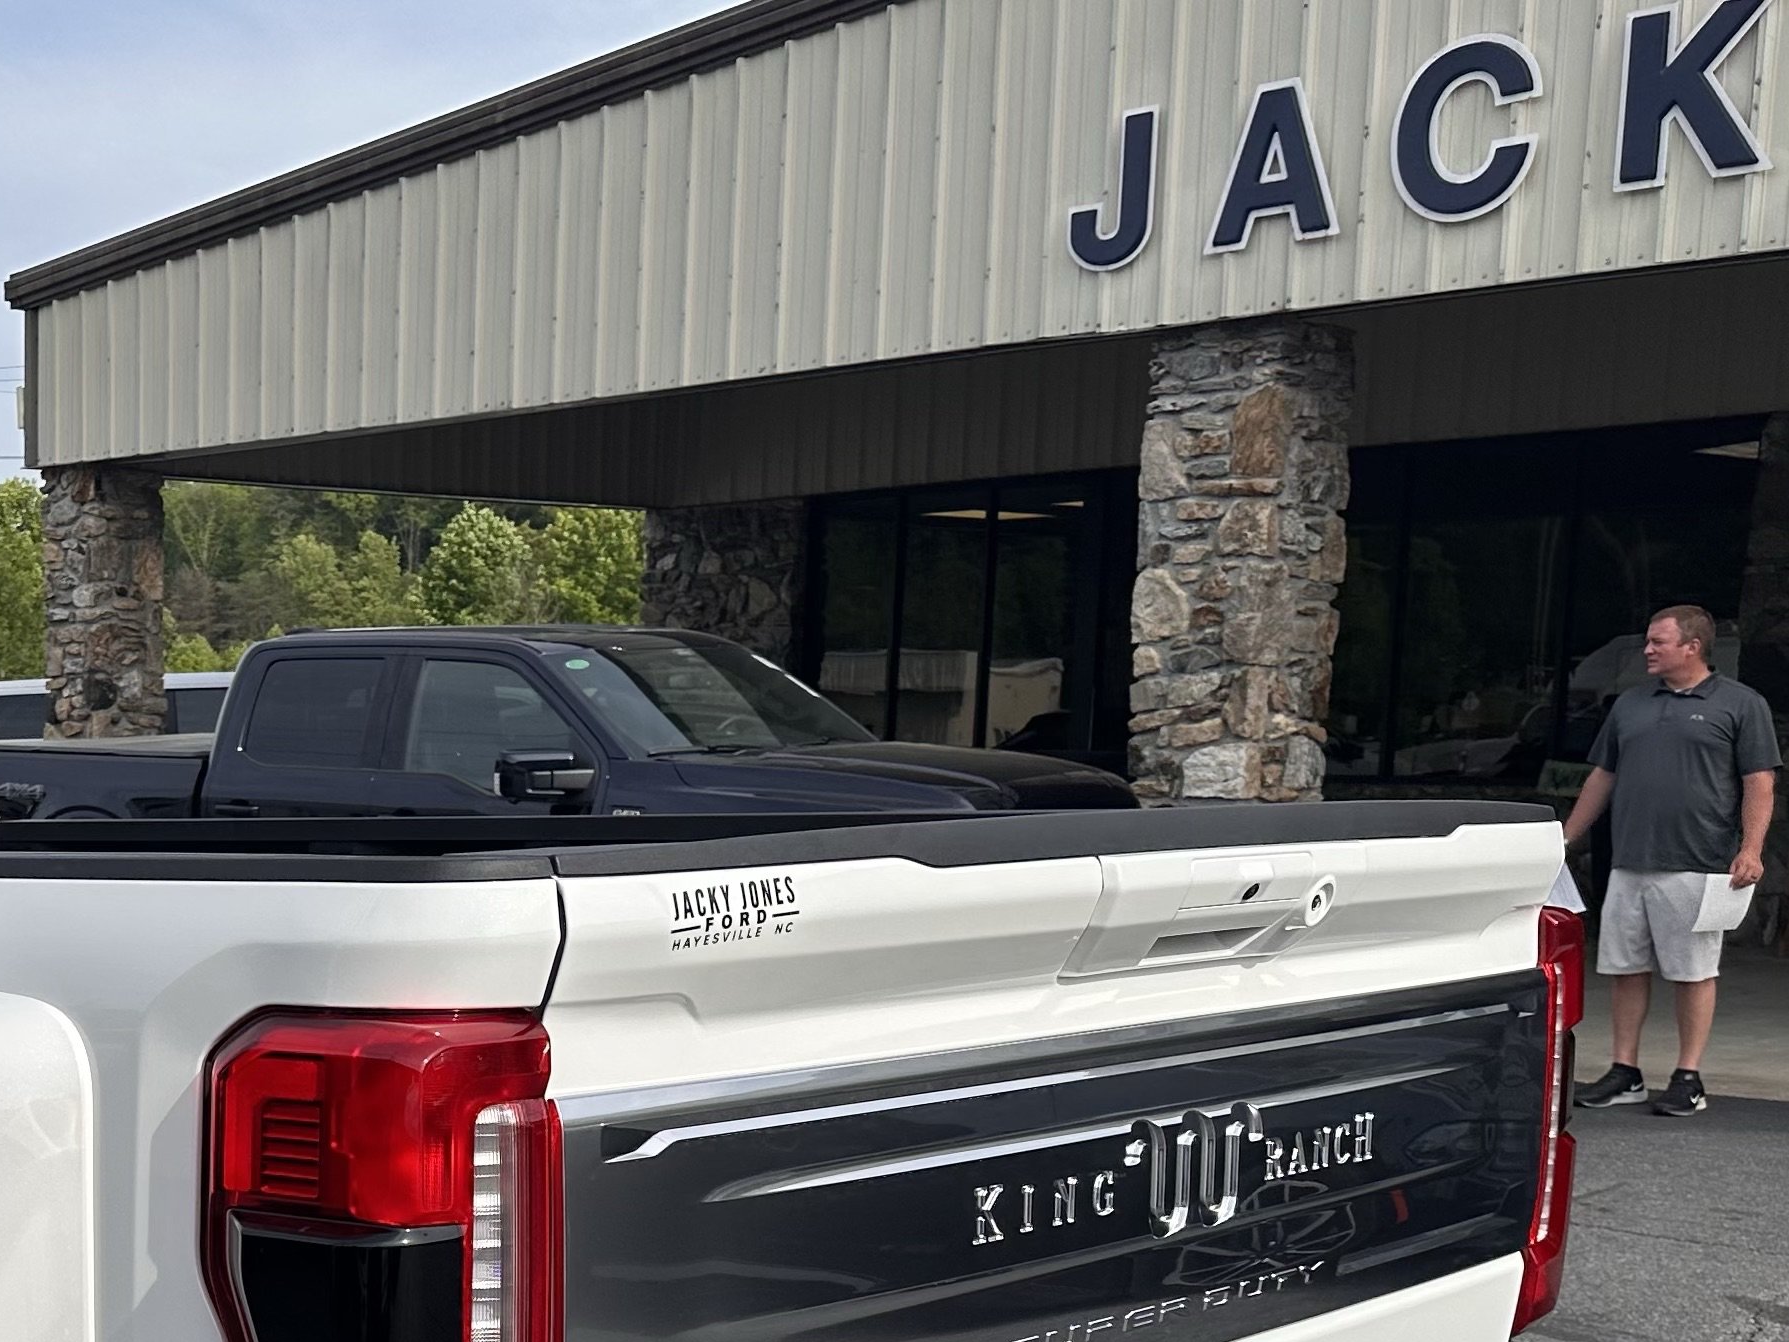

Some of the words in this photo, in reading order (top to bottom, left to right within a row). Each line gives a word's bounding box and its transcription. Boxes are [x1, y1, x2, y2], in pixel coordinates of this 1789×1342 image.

[1068, 0, 1774, 272] JACK
[672, 884, 730, 922] JACKY
[740, 876, 796, 910] JONES
[705, 909, 767, 932] FORD
[671, 926, 763, 951] HAYESVILLE
[774, 921, 794, 935] NC
[972, 1167, 1115, 1246] KING
[1264, 1111, 1375, 1181] RANCH
[1203, 1261, 1325, 1312] DUTY
